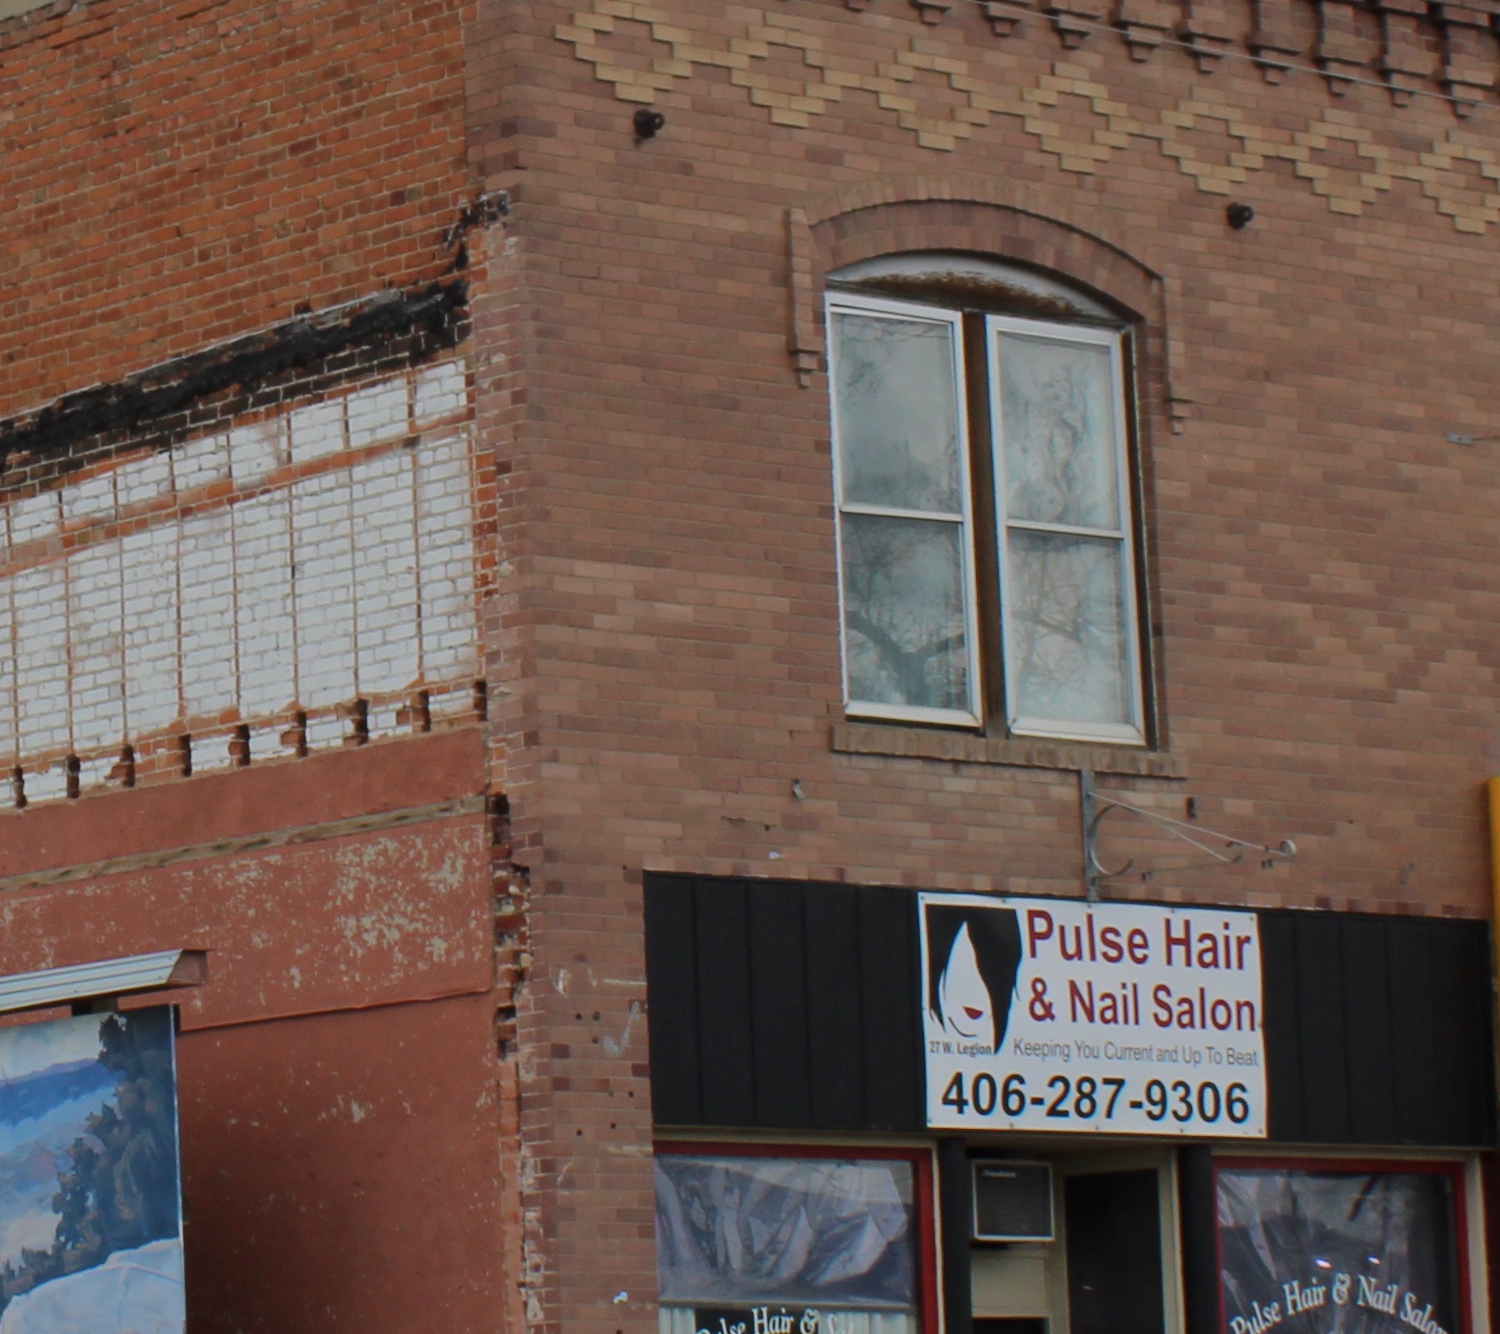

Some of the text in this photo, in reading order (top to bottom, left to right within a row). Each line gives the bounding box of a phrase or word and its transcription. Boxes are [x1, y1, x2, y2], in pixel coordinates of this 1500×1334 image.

[1027, 909, 1252, 970] Pulse Hair
[1029, 977, 1256, 1032] & Nail Salon
[929, 1040, 940, 1054] 27
[957, 1042, 993, 1058] Legion
[1013, 1038, 1259, 1067] Keeping You Current and Up To Beat
[941, 1071, 1250, 1125] 406-287-9306
[1283, 1277, 1326, 1315] Hair
[1332, 1273, 1351, 1305] &
[1357, 1274, 1398, 1315] Nail
